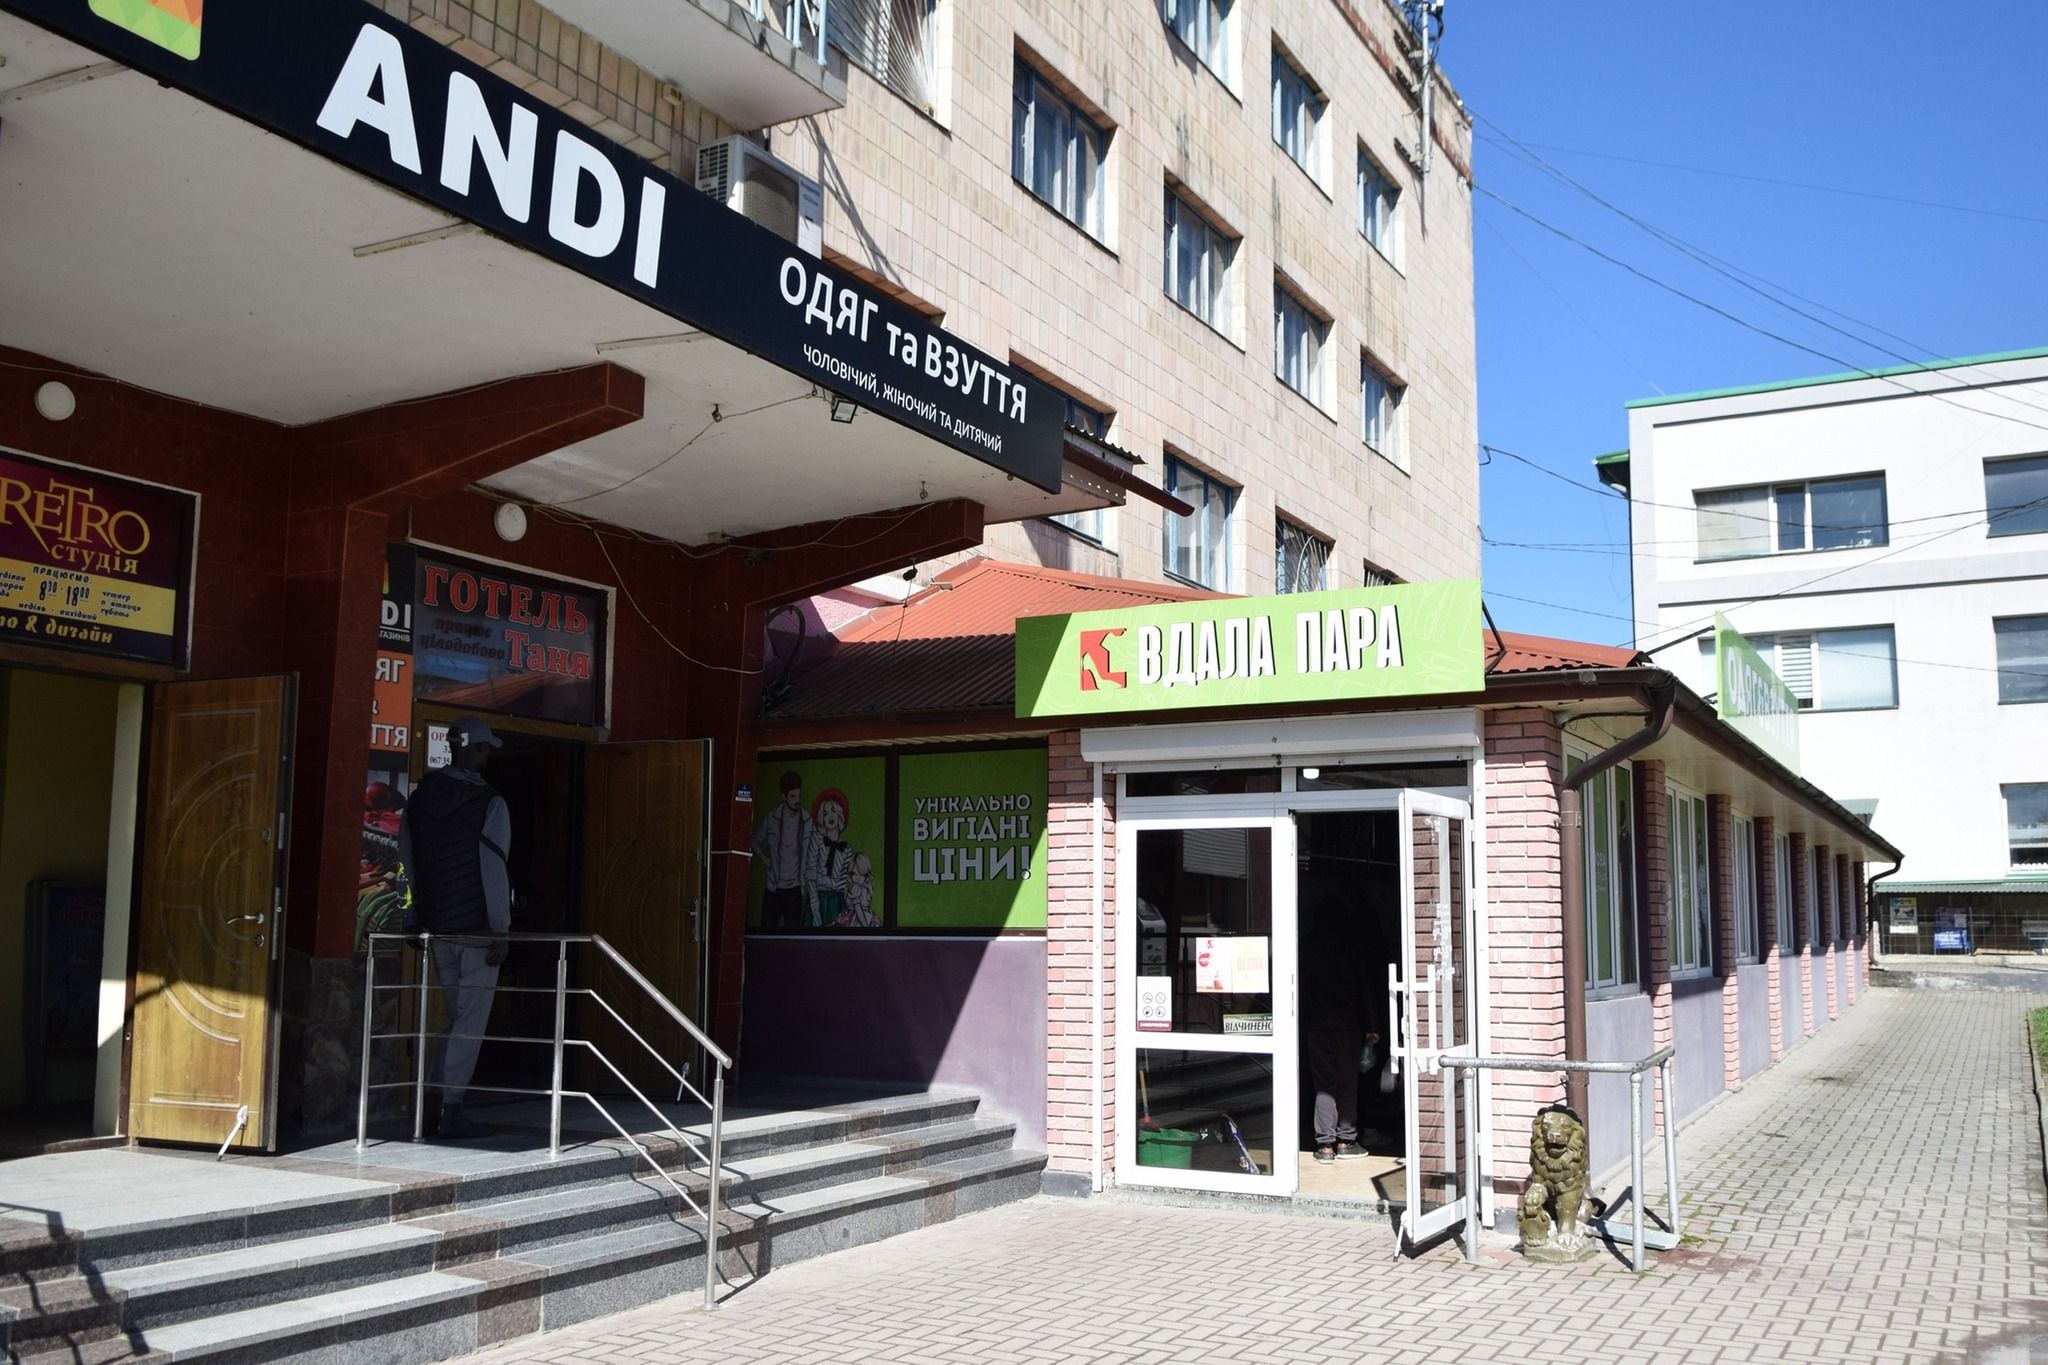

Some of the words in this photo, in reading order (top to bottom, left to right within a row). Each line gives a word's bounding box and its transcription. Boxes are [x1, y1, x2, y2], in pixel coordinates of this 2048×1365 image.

[316, 22, 666, 289] ANDI
[780, 256, 879, 342] ОДЯГ
[886, 322, 918, 368] та
[924, 334, 1027, 424] ВЗУТТЯ
[804, 343, 880, 398] ЧОЛОВІЧИЙ,
[883, 383, 937, 424] ЖІНОЧИЙ
[939, 410, 952, 431] ТА
[953, 418, 1002, 454] ДИТЯЧИЙ
[51, 544, 139, 575] студія
[423, 564, 589, 635] ГОТЕЛЬ
[45, 617, 113, 644] дизайн
[504, 629, 592, 680] Таня
[1138, 615, 1276, 688] ВДАЛА
[1297, 604, 1404, 674] ПАРА
[913, 815, 1031, 842] ВИГІДНІ
[914, 794, 1031, 814] УНІКАЛЬНО
[913, 846, 1031, 885] ЦІНИ!
